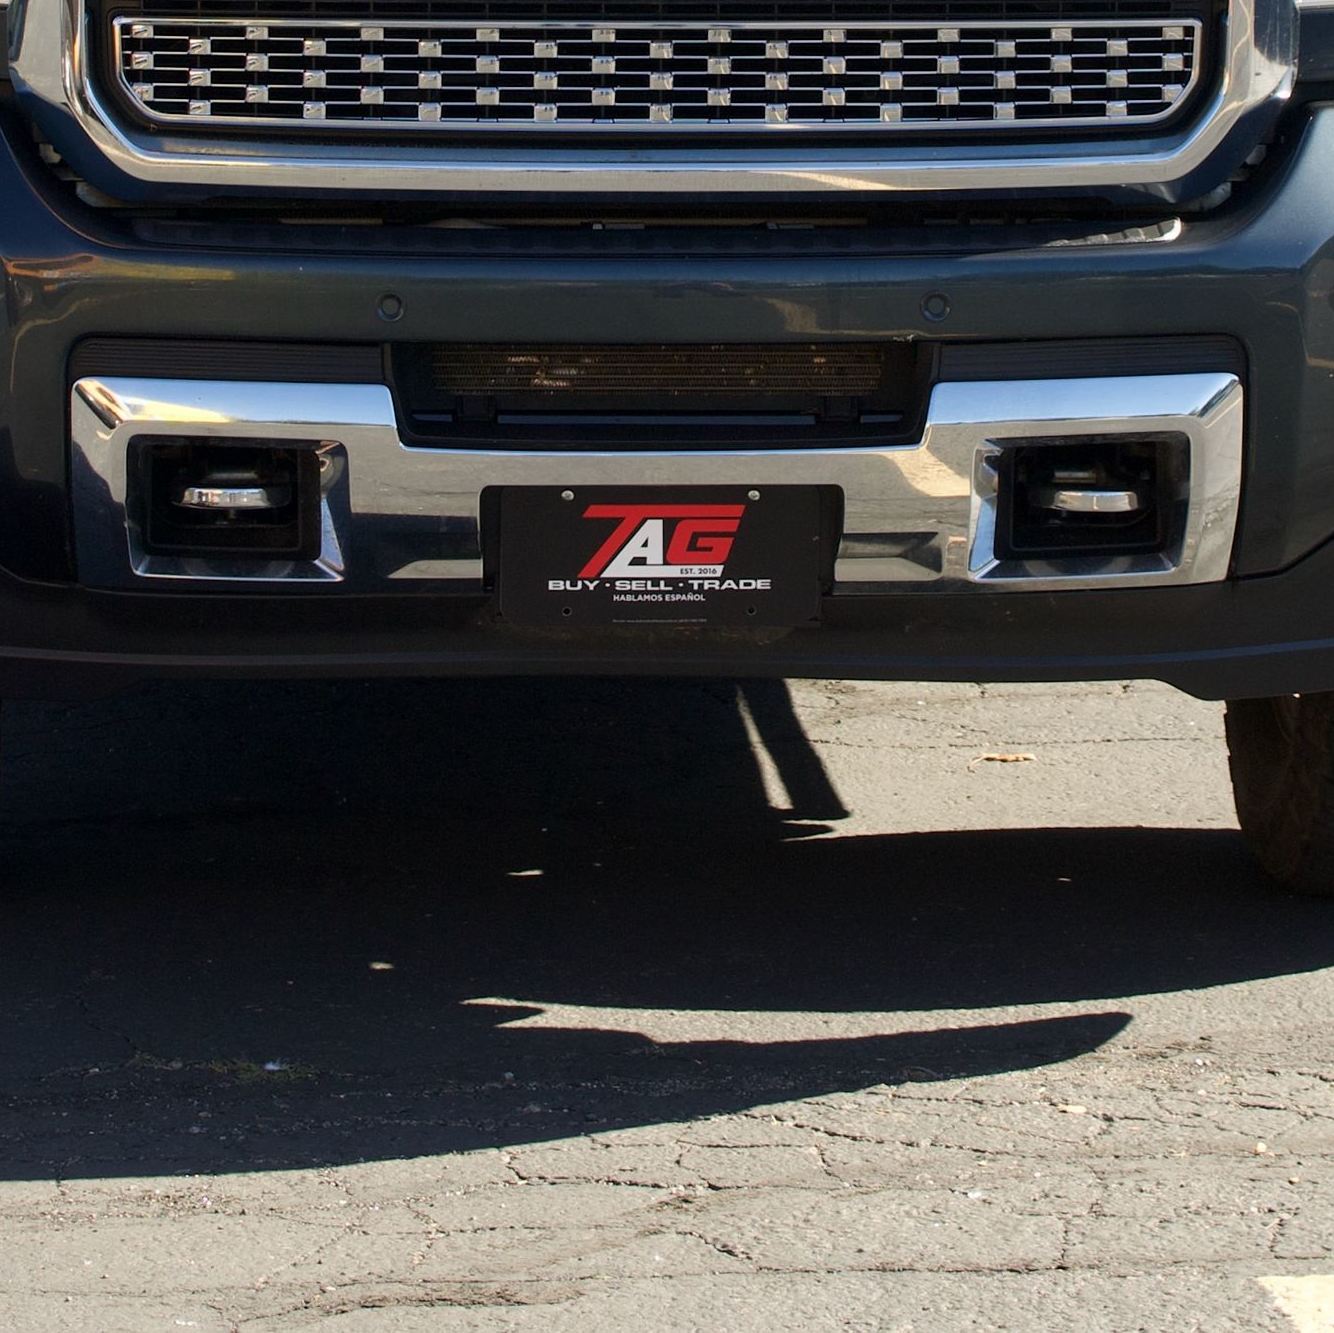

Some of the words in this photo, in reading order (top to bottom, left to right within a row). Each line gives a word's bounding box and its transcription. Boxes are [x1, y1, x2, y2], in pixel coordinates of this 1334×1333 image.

[577, 505, 746, 578] TAG
[679, 567, 697, 575] EST.
[698, 567, 718, 575] 2016
[548, 580, 599, 591] BUY
[614, 580, 673, 591] SELL
[688, 579, 772, 590] TRADE
[613, 593, 663, 602] HABLAMOS
[665, 591, 706, 601] ESPAÑOL
